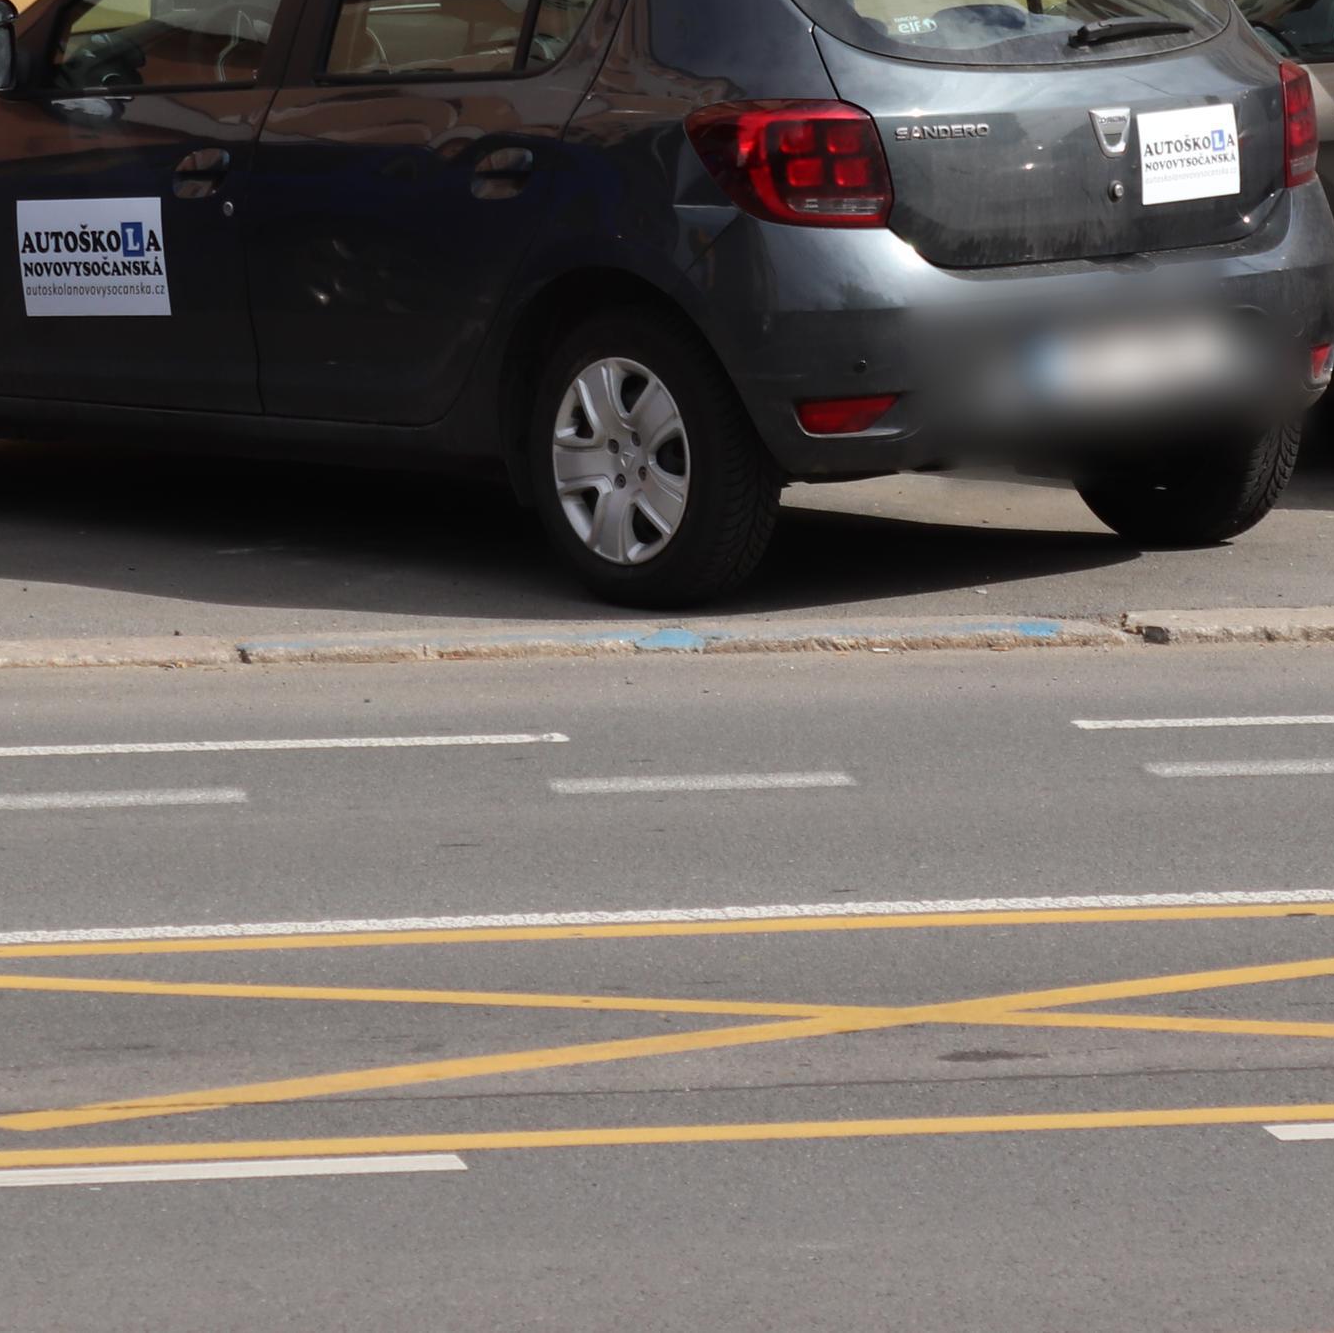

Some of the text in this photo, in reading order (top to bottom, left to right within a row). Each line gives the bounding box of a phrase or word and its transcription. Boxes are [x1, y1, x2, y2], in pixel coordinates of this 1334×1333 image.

[898, 20, 922, 34] elf
[895, 123, 990, 141] SANDERO
[1144, 129, 1235, 157] AUTOŠKOLA
[1145, 150, 1236, 173] NOVOVYSOČANSKÁ
[21, 223, 162, 255] AUTOŠKOLA
[22, 256, 164, 277] NOVOVYSOČANSKÁ
[25, 282, 165, 298] autoskolanovovysocanska.cz
